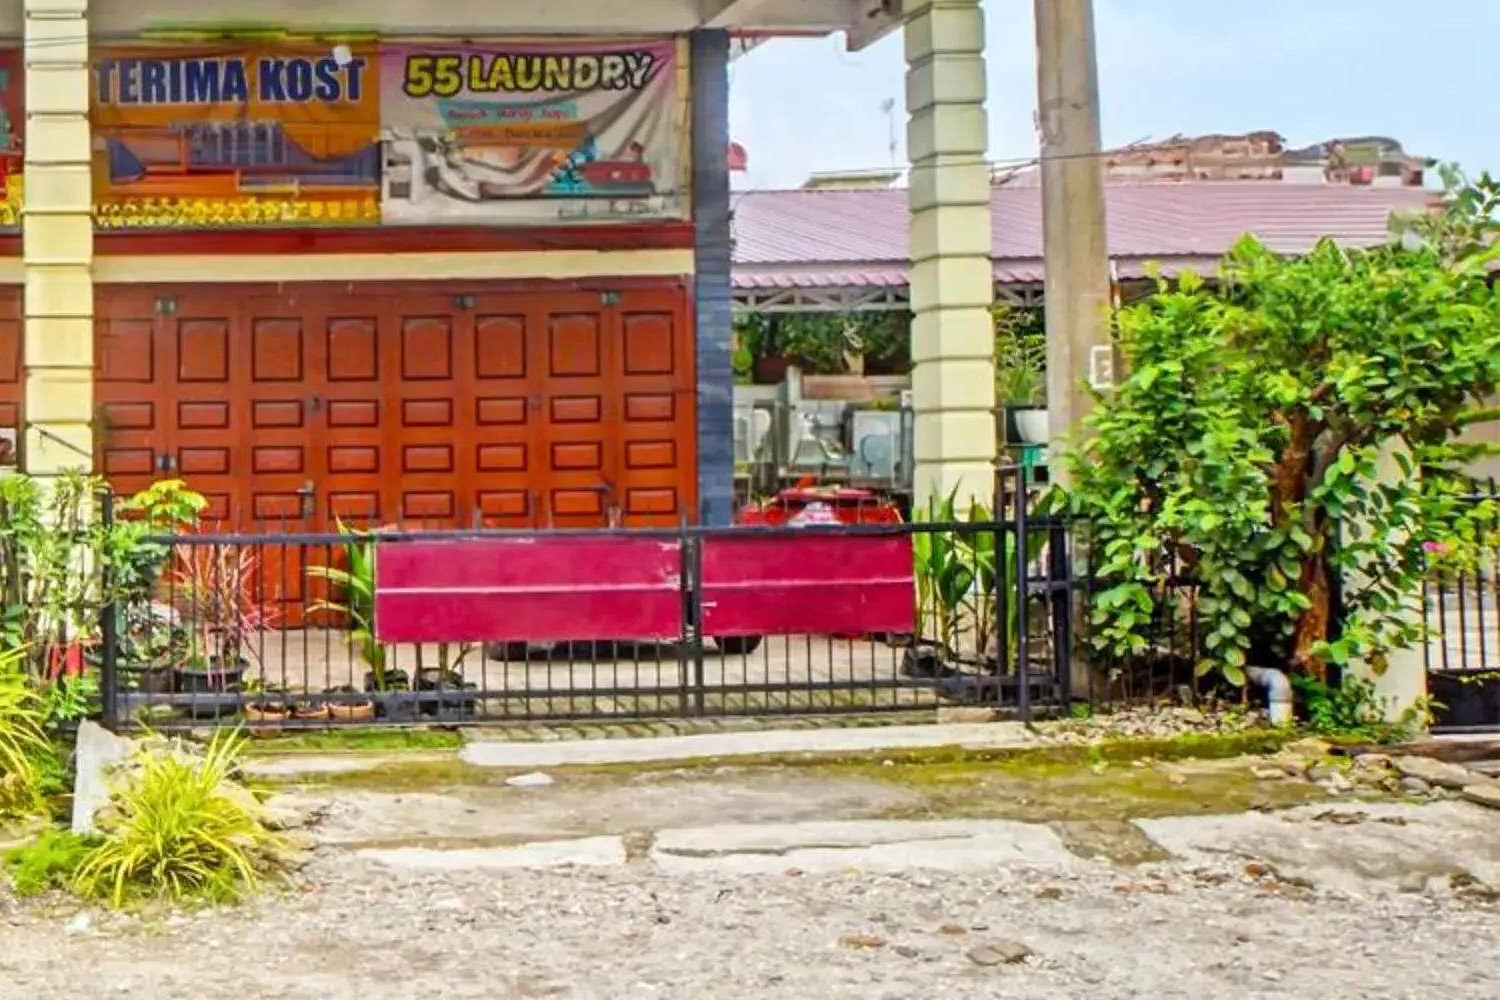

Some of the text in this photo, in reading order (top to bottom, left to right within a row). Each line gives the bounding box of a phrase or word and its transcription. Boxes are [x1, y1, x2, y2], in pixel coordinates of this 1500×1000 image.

[92, 56, 367, 104] TERIMA KOST
[407, 53, 654, 96] 55 LAUNDRY
